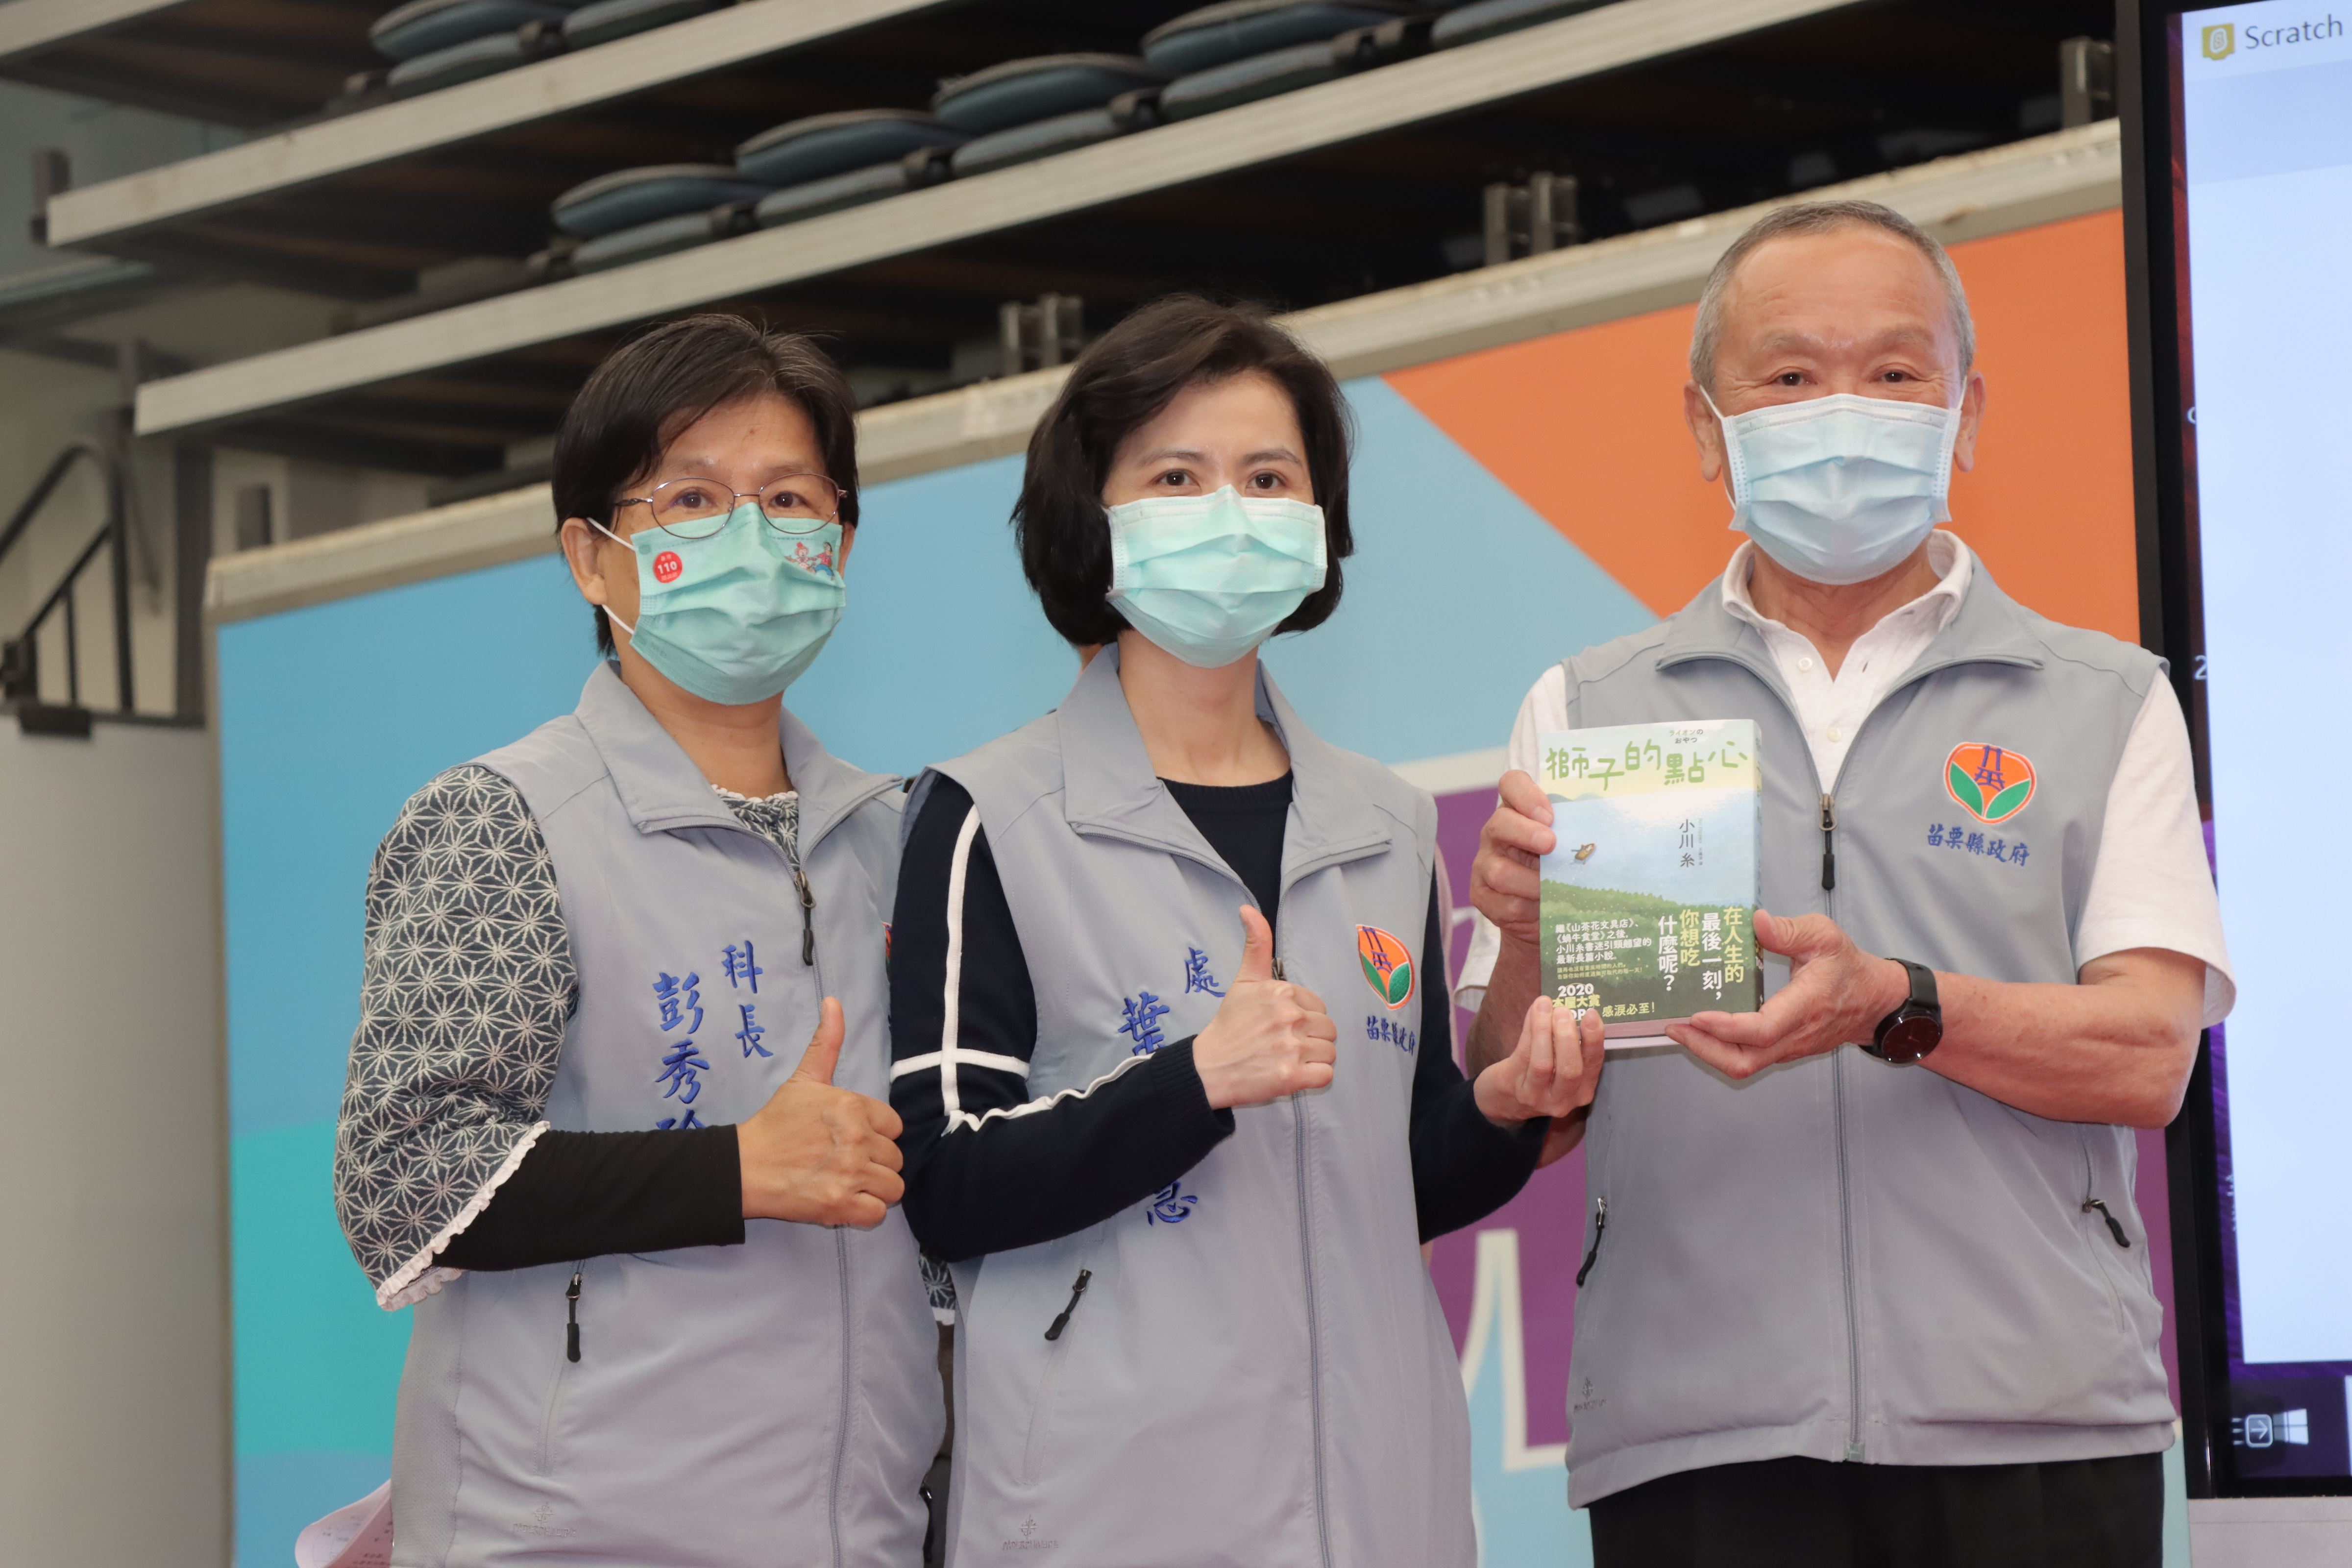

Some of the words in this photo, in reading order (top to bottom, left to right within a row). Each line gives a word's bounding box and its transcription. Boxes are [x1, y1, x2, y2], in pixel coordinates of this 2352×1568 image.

[2246, 13, 2343, 49] Scratch
[658, 561, 677, 574] 110
[1669, 729, 1703, 737] ライオンの
[1545, 738, 1748, 791] 獅子的點心
[1679, 819, 1695, 867] 小川糸
[1927, 823, 2030, 866] 苗栗縣政府
[1679, 909, 1700, 967] 你想吃
[1723, 906, 1744, 983] 在人生的
[721, 940, 774, 1058] 科長
[1558, 983, 1594, 998] 2020
